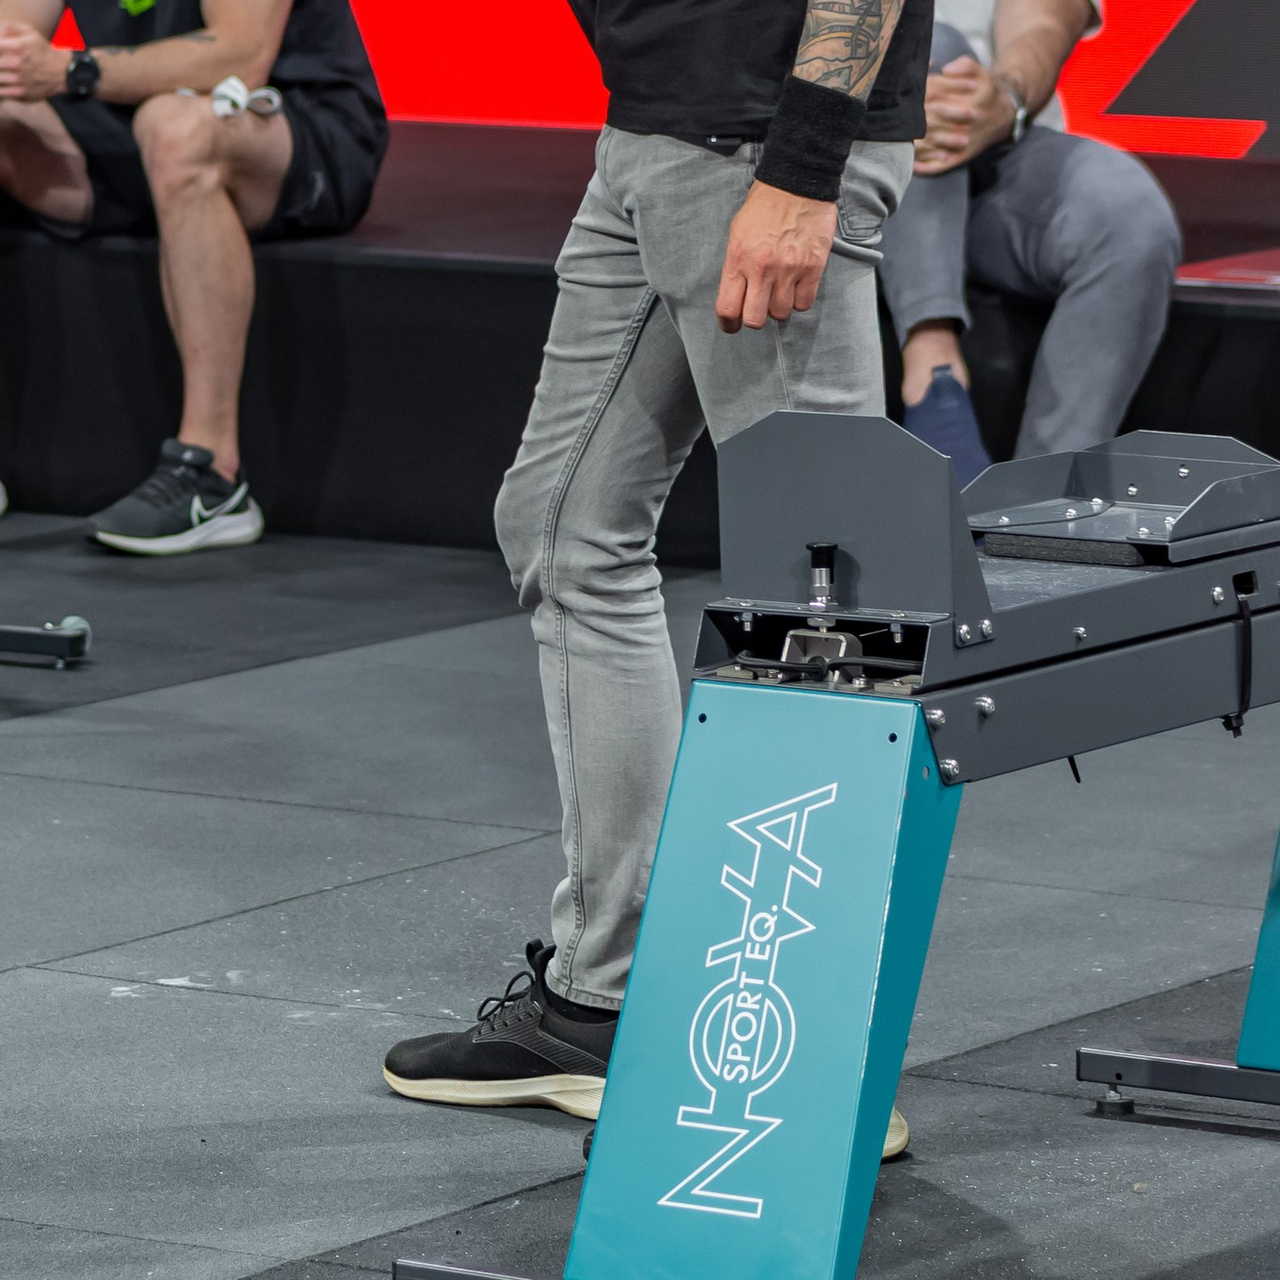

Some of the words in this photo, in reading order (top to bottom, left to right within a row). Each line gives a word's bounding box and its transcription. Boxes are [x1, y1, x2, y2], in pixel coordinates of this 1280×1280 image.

[657, 782, 838, 1219] NOVA
[722, 971, 765, 1084] SPORT
[745, 904, 779, 961] EQ.
